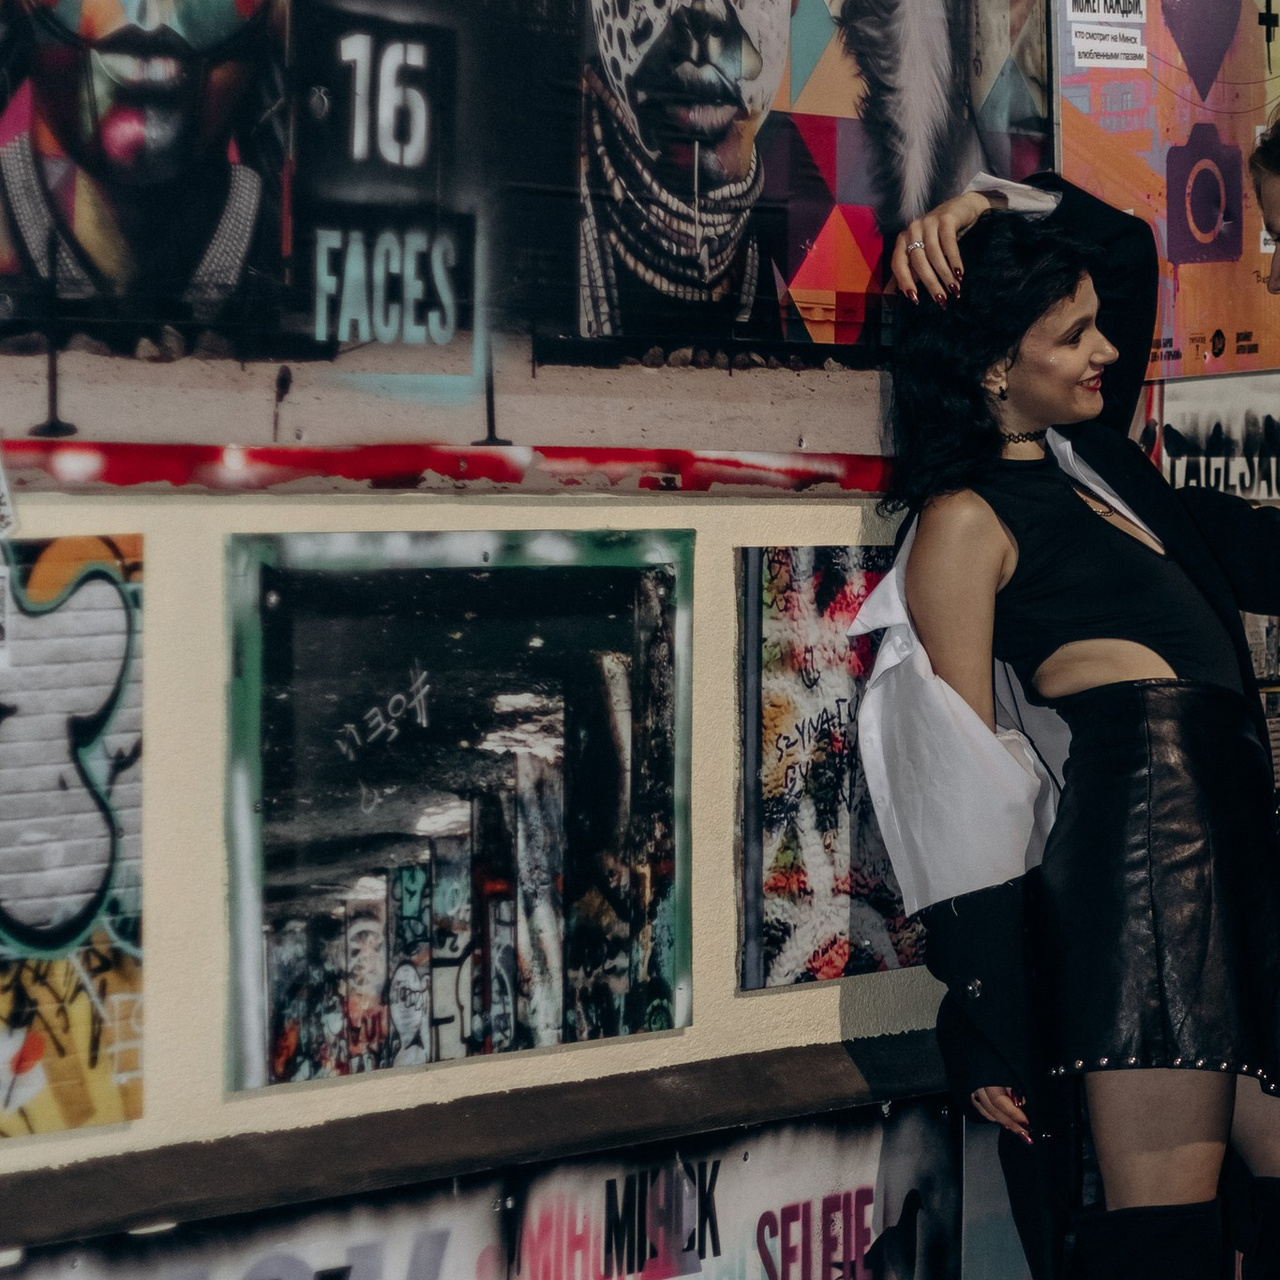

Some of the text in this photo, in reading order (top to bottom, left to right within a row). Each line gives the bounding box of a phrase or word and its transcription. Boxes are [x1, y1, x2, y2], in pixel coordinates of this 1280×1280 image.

[1075, 31, 1085, 40] кто
[1086, 32, 1109, 43] смотрит
[337, 34, 429, 168] 16
[315, 229, 456, 346] FACES
